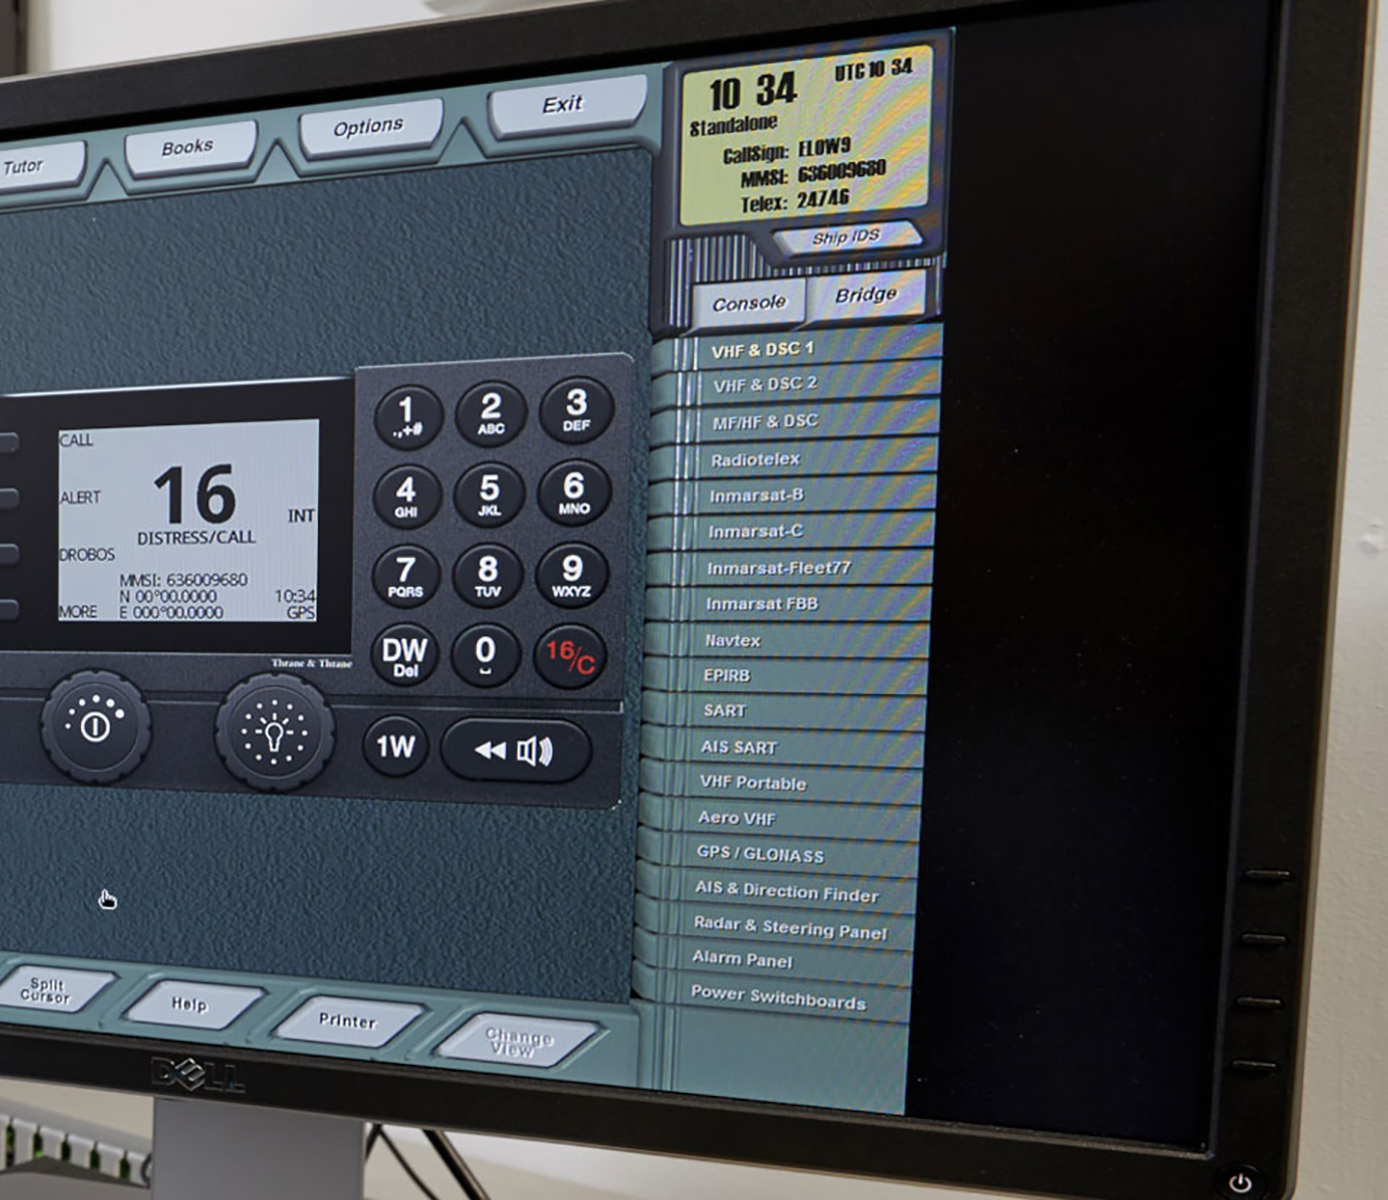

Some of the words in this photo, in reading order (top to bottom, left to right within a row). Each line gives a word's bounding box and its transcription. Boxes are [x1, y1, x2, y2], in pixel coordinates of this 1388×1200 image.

[835, 63, 865, 82] UTC
[869, 60, 885, 78] 10
[891, 57, 913, 75] 34
[709, 78, 740, 111] 10
[756, 71, 798, 106] 34
[542, 94, 582, 114] Exit
[333, 117, 403, 140] Options
[690, 115, 778, 137] Standalone
[161, 136, 213, 157] Books
[723, 144, 789, 166] CallSign:
[3, 156, 43, 175] Tutor
[741, 170, 789, 188] MMSI:
[798, 158, 887, 183] 636009680
[742, 196, 788, 213] Telex:
[797, 188, 850, 209] 24746
[812, 230, 848, 248] Ship
[852, 228, 880, 242] IDS
[712, 293, 787, 313] Console
[835, 286, 898, 304] Bridge
[712, 344, 744, 360] VHF
[748, 343, 761, 356] &
[765, 341, 800, 356] DSC
[805, 340, 815, 354] 1
[714, 379, 747, 394] VHF
[750, 378, 763, 391] &
[767, 377, 803, 390] DSC
[807, 376, 818, 389] 2
[399, 396, 412, 422] 1
[481, 392, 502, 419] 2
[566, 388, 588, 416] 3
[478, 423, 505, 435] ABC
[563, 419, 591, 432] DEF
[712, 415, 762, 431] MF/HF
[766, 415, 780, 429] &
[784, 413, 819, 428] DSC
[59, 433, 93, 447] CALL
[712, 452, 801, 468] Radiotelex
[396, 476, 416, 503] 4
[479, 474, 500, 501] 5
[563, 471, 585, 499] 6
[60, 490, 101, 504] ALERT
[153, 464, 236, 525] 16
[710, 488, 805, 504] Inmarsat-B
[288, 508, 315, 523] INT
[394, 506, 418, 518] GHI
[478, 505, 502, 517] JKL
[559, 502, 591, 515] MNO
[138, 530, 256, 546] DISTRESS/CALL
[709, 524, 804, 540] Inmarsat-C
[59, 548, 115, 562] DROBOS
[396, 556, 416, 582] 7
[478, 555, 499, 582] 8
[562, 554, 584, 582] 9
[707, 561, 852, 576] Inmarsat-Fleet77
[120, 573, 161, 588] MMSI:
[167, 573, 248, 587] 636009680
[120, 590, 130, 603] N
[275, 589, 316, 603] 10:34
[388, 586, 424, 598] PQRS
[475, 586, 502, 597] TUV
[552, 586, 591, 597] WXYZ
[59, 605, 97, 618] MORE
[120, 606, 128, 619] E
[286, 605, 315, 620] GPS
[706, 597, 783, 611] Inmarsat
[786, 597, 820, 611] FBB
[475, 636, 496, 663] 0
[705, 634, 762, 648] Navtex
[382, 638, 428, 663] DW
[306, 659, 315, 668] &
[393, 664, 419, 678] Del
[703, 668, 751, 683] EPIRB
[703, 704, 747, 718] SART
[376, 734, 416, 759] 1W
[701, 740, 729, 754] AIS
[734, 740, 778, 755] SART
[700, 774, 732, 789] VHF
[736, 775, 808, 792] Portable
[698, 810, 739, 825] Aero
[743, 811, 777, 827] VHF
[697, 844, 730, 860] GPS
[743, 846, 825, 865] GLONASS
[695, 880, 723, 895] AIS
[727, 881, 739, 895] &
[743, 882, 819, 900] Direction
[823, 887, 879, 904] Finder
[694, 915, 741, 932] Radar
[745, 919, 757, 932] &
[762, 919, 835, 940] Steering
[839, 925, 888, 941] Panel
[692, 950, 742, 966] Alarm
[747, 953, 793, 970] Panel
[30, 977, 64, 993] Split
[20, 988, 70, 1005] Cursor
[171, 997, 207, 1014] Help
[691, 984, 746, 1002] Power
[750, 989, 867, 1012] Switchboards
[319, 1012, 378, 1030] Printer
[485, 1027, 554, 1047] Change
[491, 1041, 536, 1057] View
[151, 1058, 246, 1093] DELL
